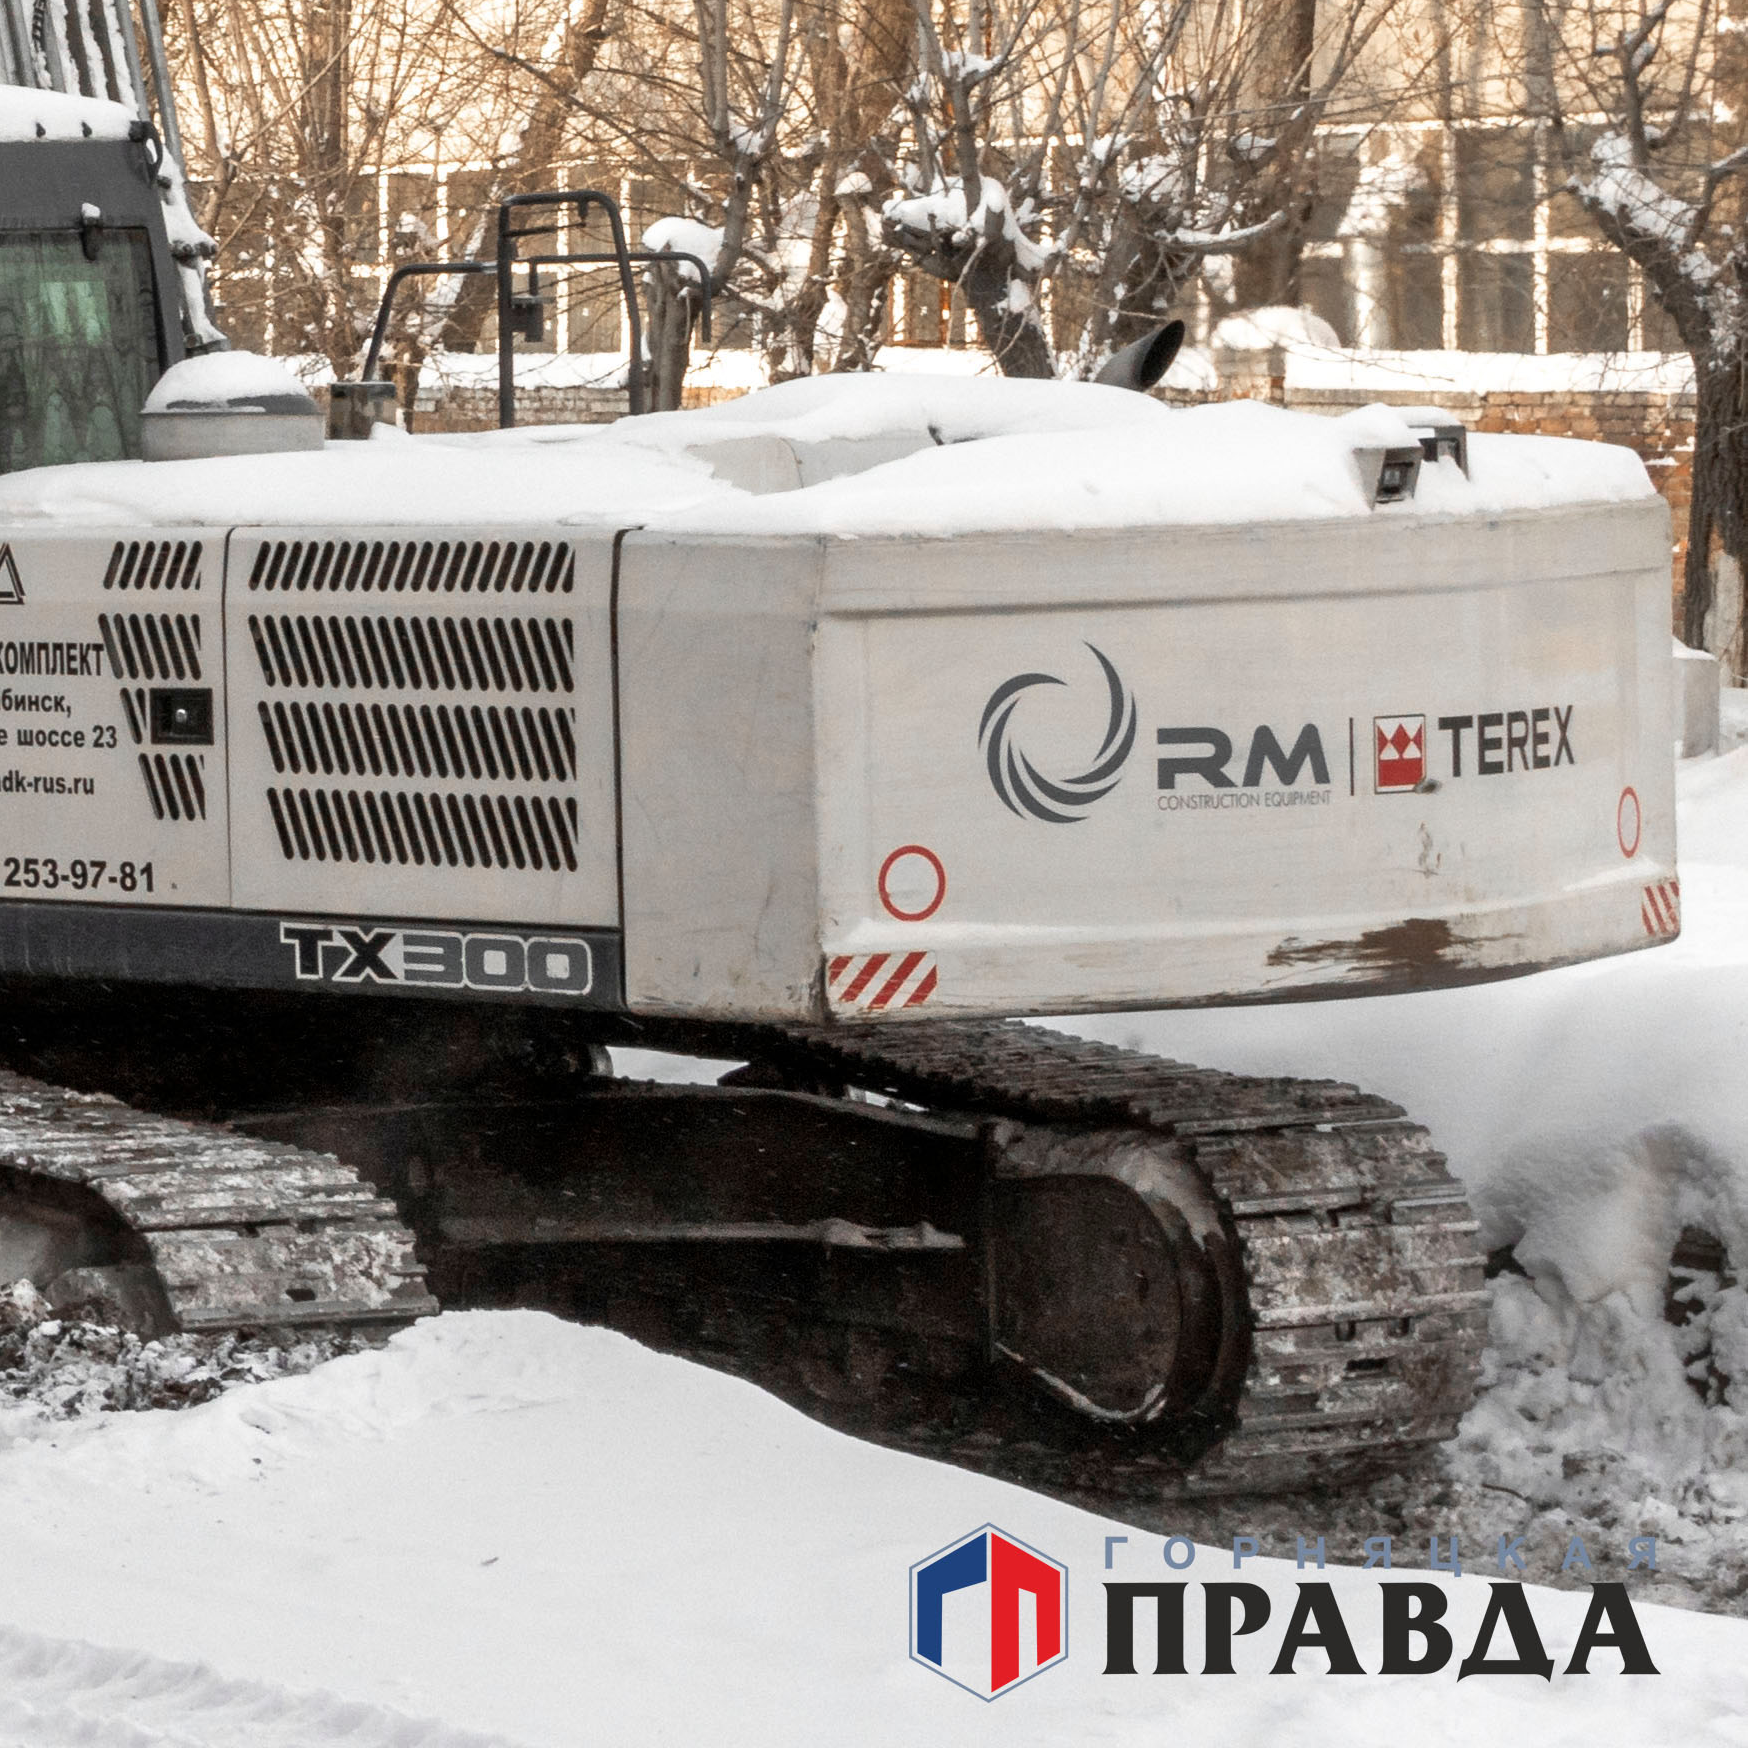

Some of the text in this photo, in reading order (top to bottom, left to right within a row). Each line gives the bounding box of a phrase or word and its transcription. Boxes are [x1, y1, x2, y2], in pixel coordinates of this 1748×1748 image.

[17, 732, 85, 747] шоссе
[92, 725, 117, 749] 23
[1157, 723, 1331, 790] RM
[1439, 705, 1575, 777] TEREX
[1157, 790, 1331, 811] CONSTRUCTION EQUIPMENT
[3, 856, 154, 893] 253-97-81
[280, 922, 592, 995] TX300
